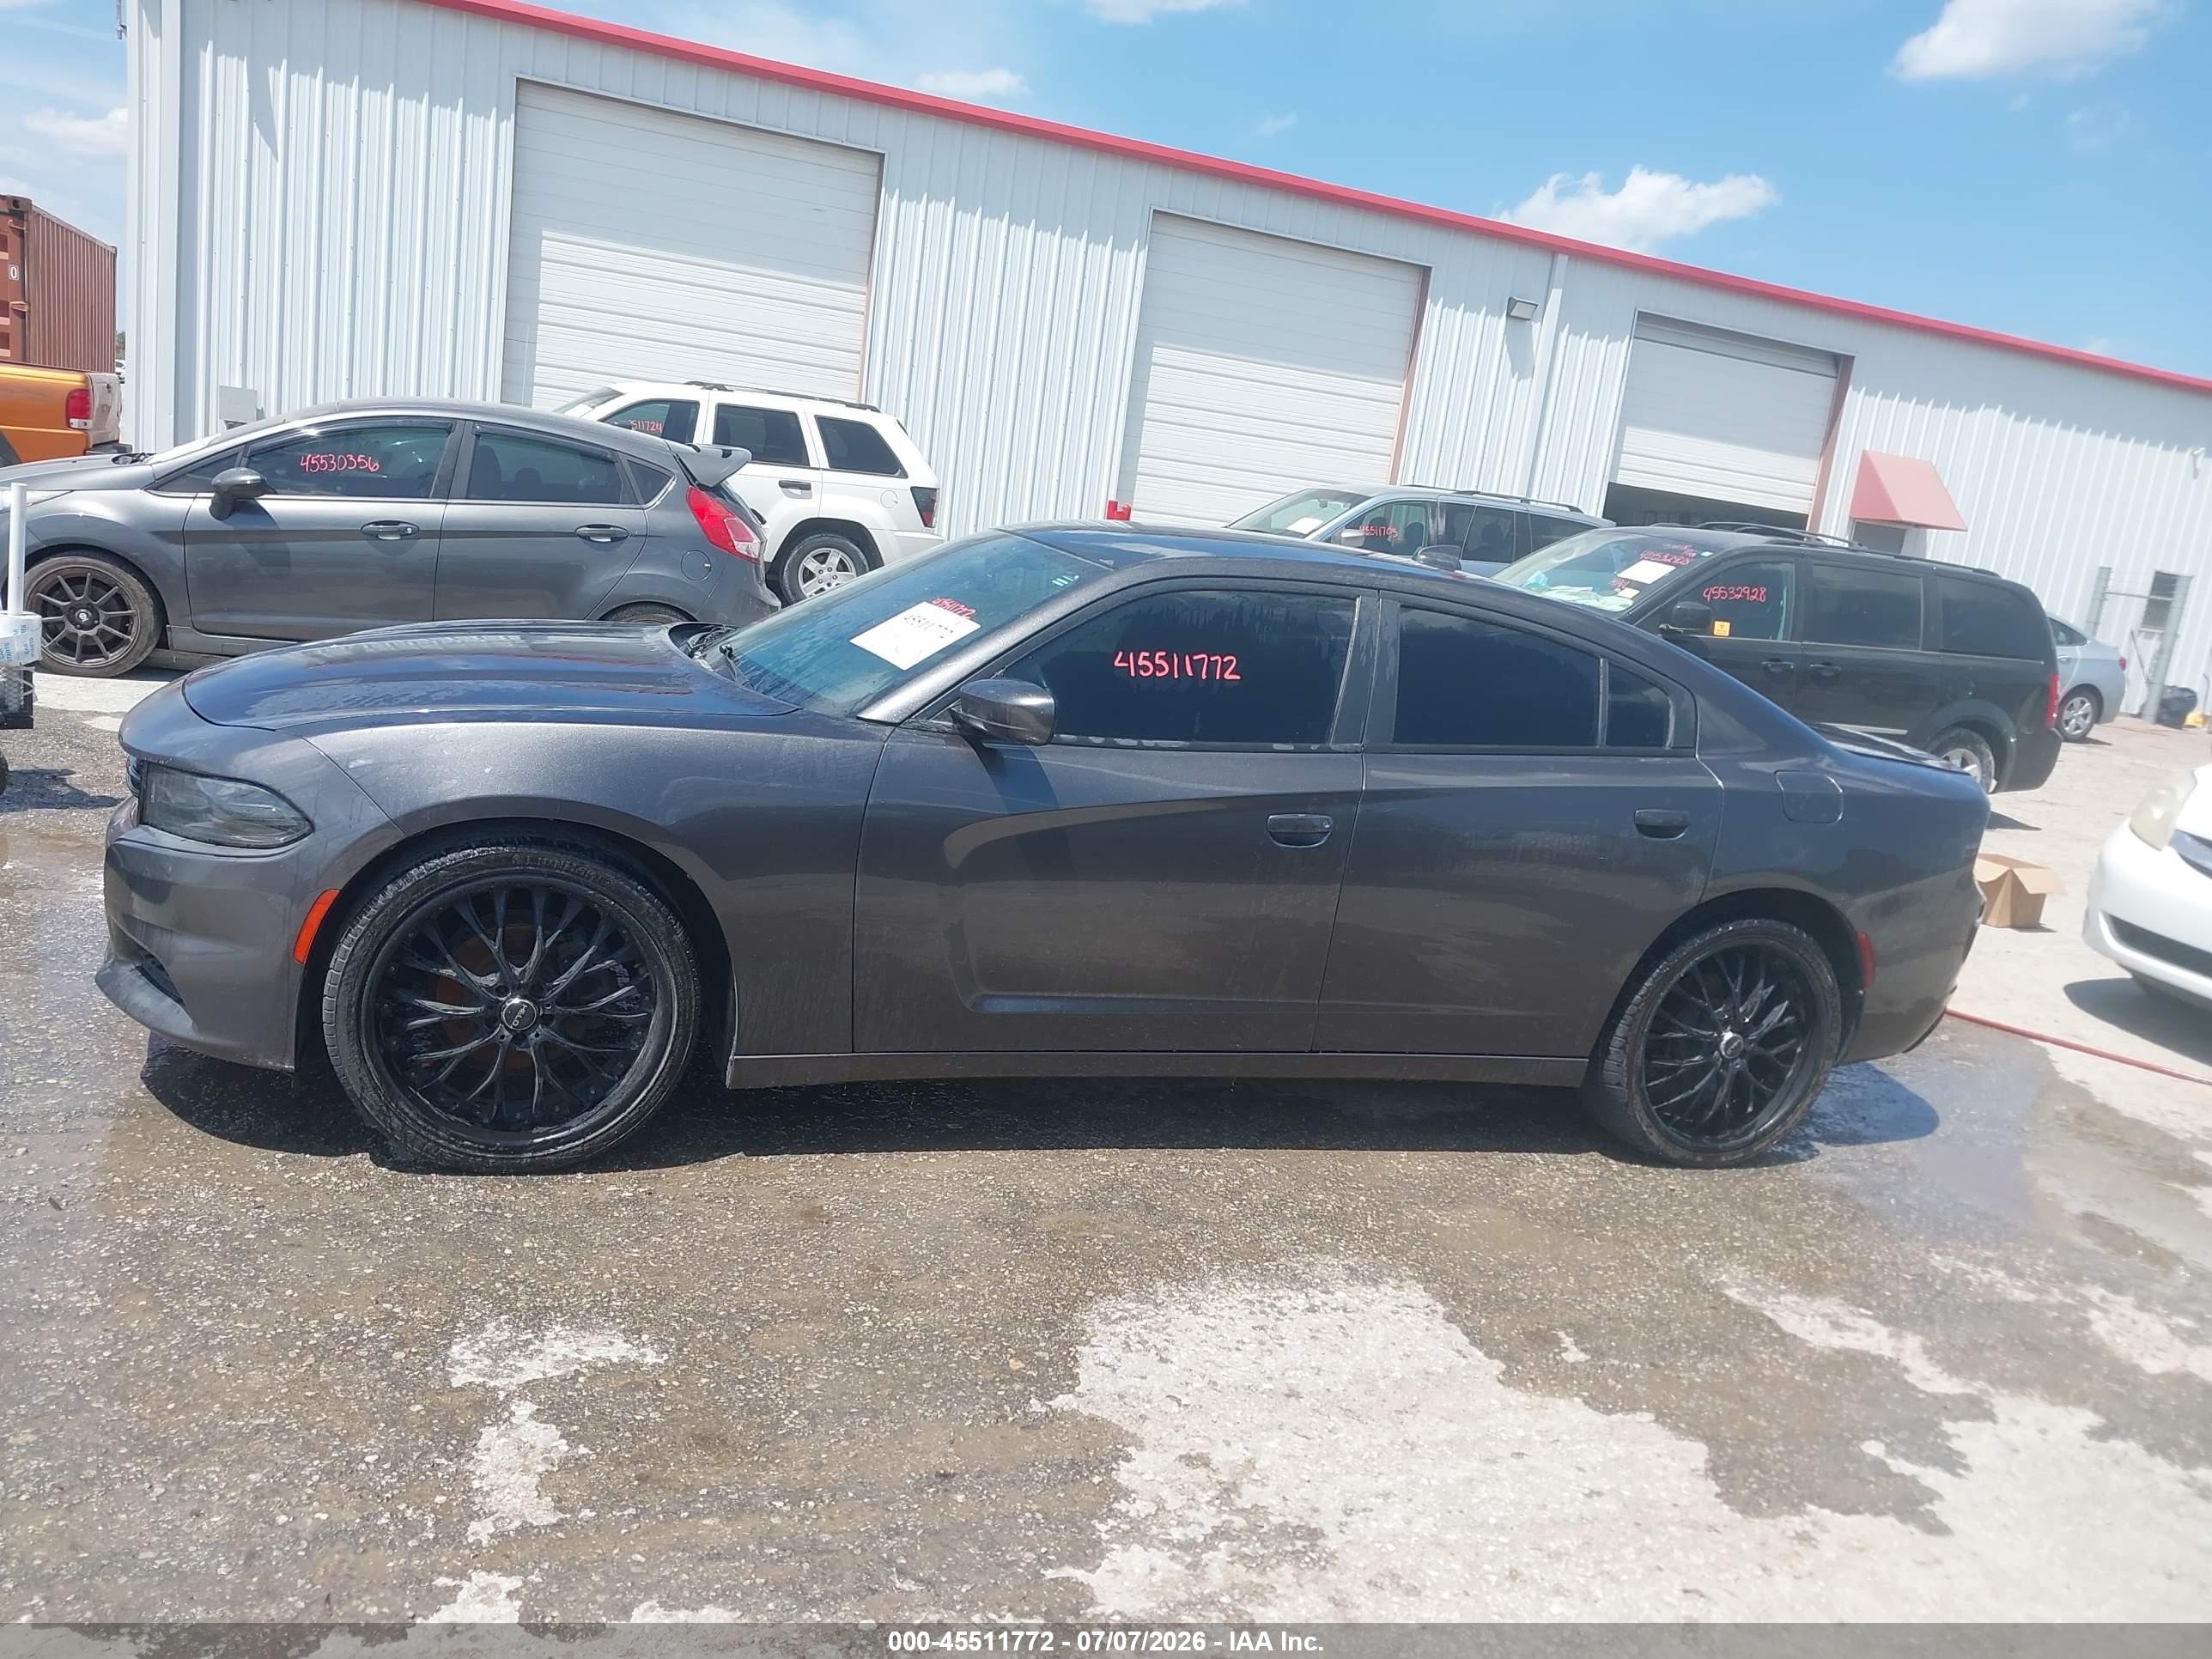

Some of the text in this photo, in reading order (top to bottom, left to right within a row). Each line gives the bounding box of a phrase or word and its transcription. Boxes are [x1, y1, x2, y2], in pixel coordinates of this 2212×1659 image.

[300, 453, 380, 472] 45530356
[1703, 586, 1766, 603] 45532928
[1114, 650, 1242, 680] 45511772
